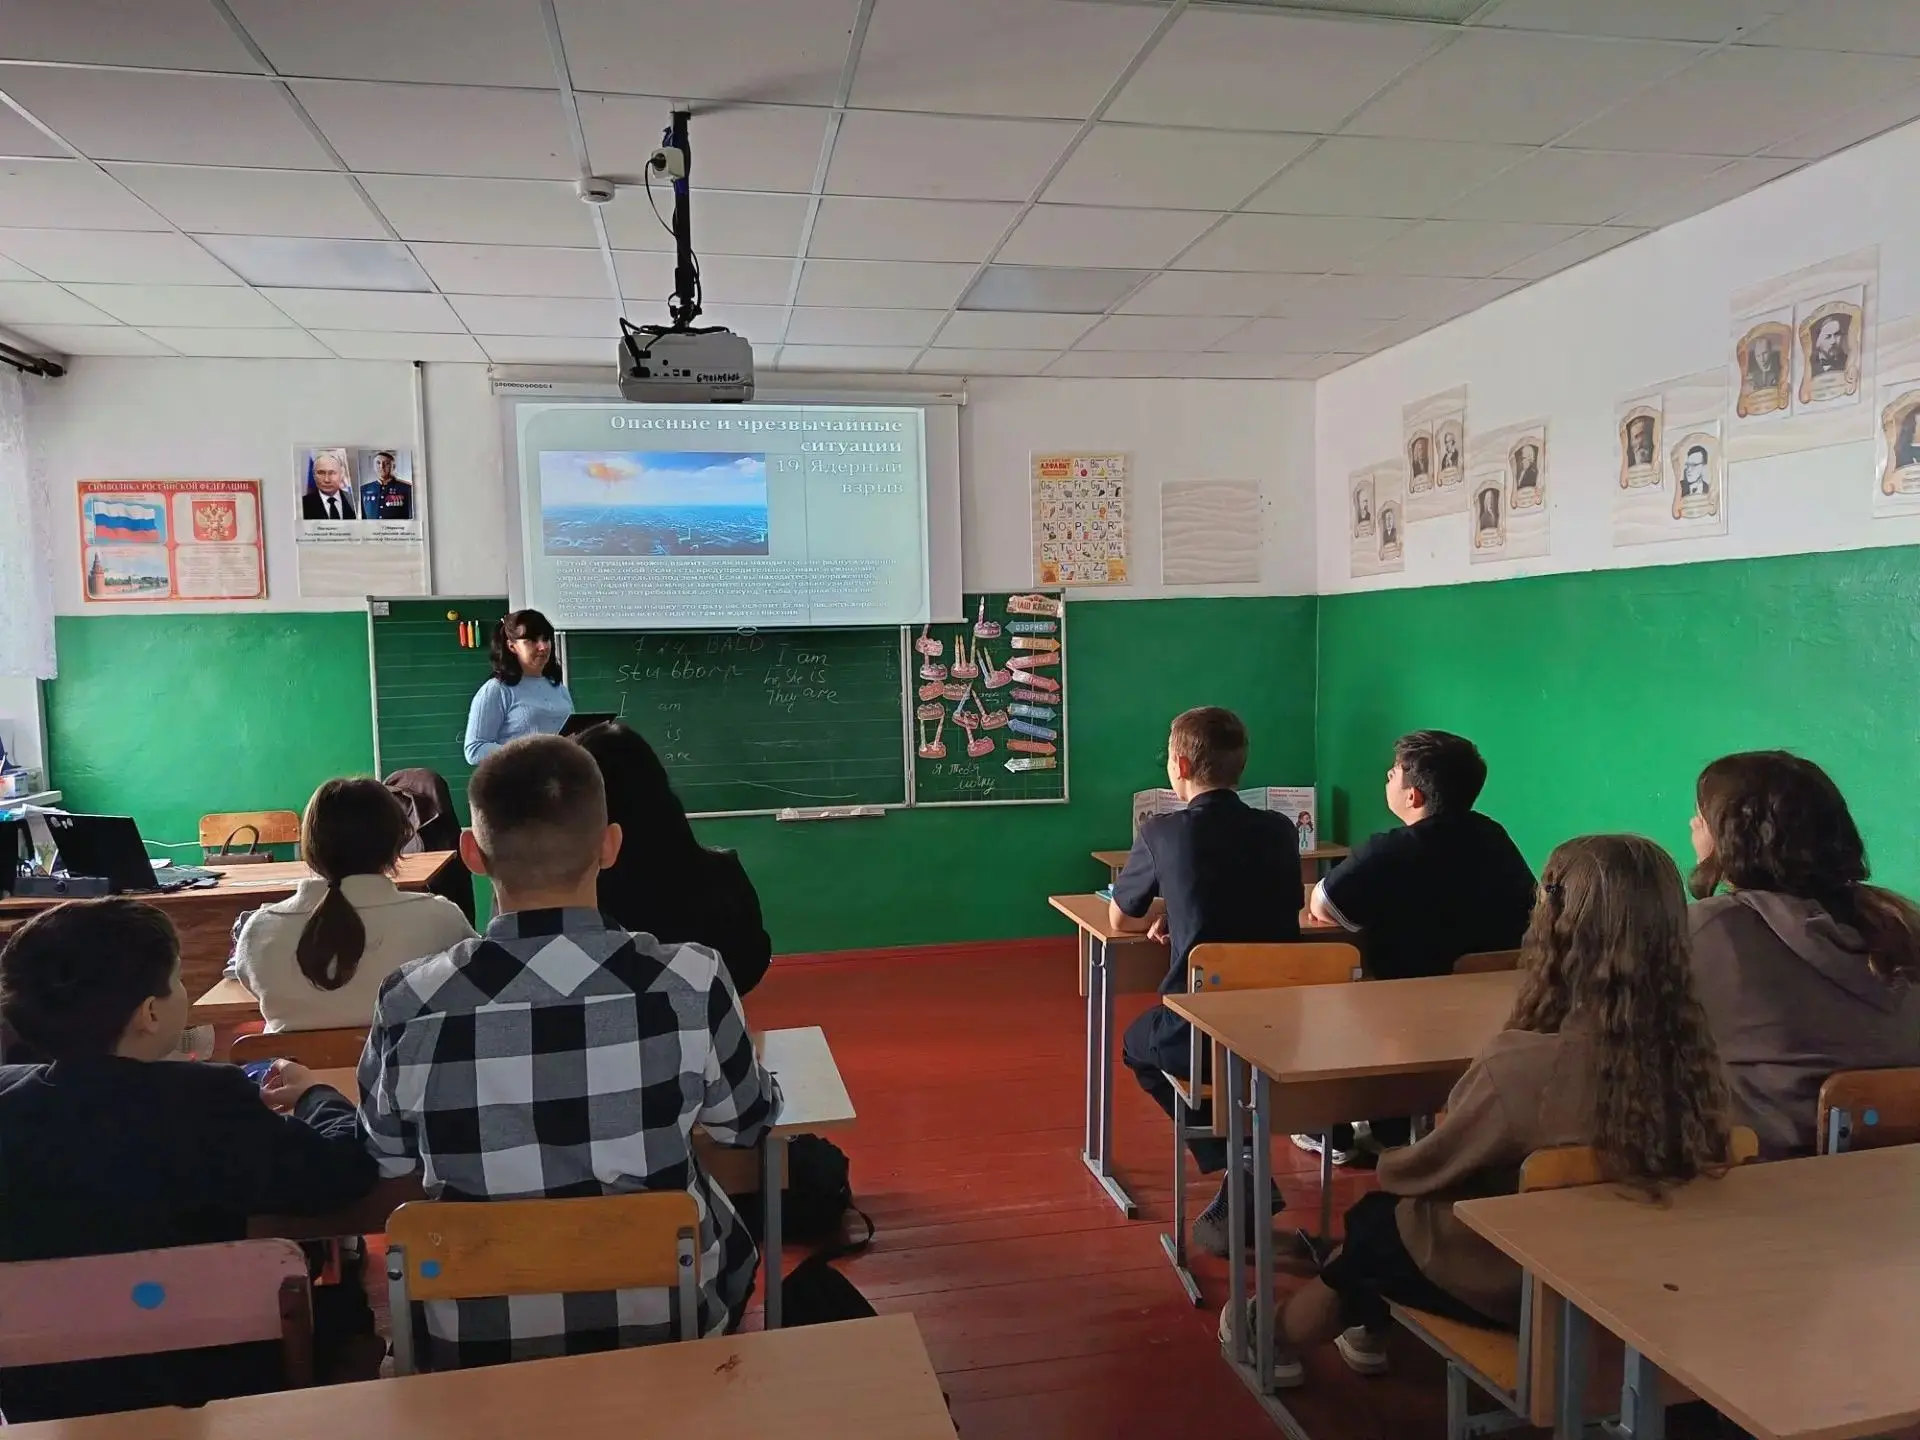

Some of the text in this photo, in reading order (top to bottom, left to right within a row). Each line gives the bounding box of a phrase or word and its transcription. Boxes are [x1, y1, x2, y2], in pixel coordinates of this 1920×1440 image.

[610, 416, 903, 434] Опасные и чрезвычайные
[800, 440, 902, 456] ситуации
[811, 459, 902, 476] Ядерный
[142, 483, 198, 491] РОССИЙСКОЙ
[199, 483, 249, 491] ФЕДЕРАЦИИ
[841, 483, 904, 496] взрыв
[797, 653, 829, 666] am
[810, 666, 825, 683] is
[803, 688, 838, 704] are
